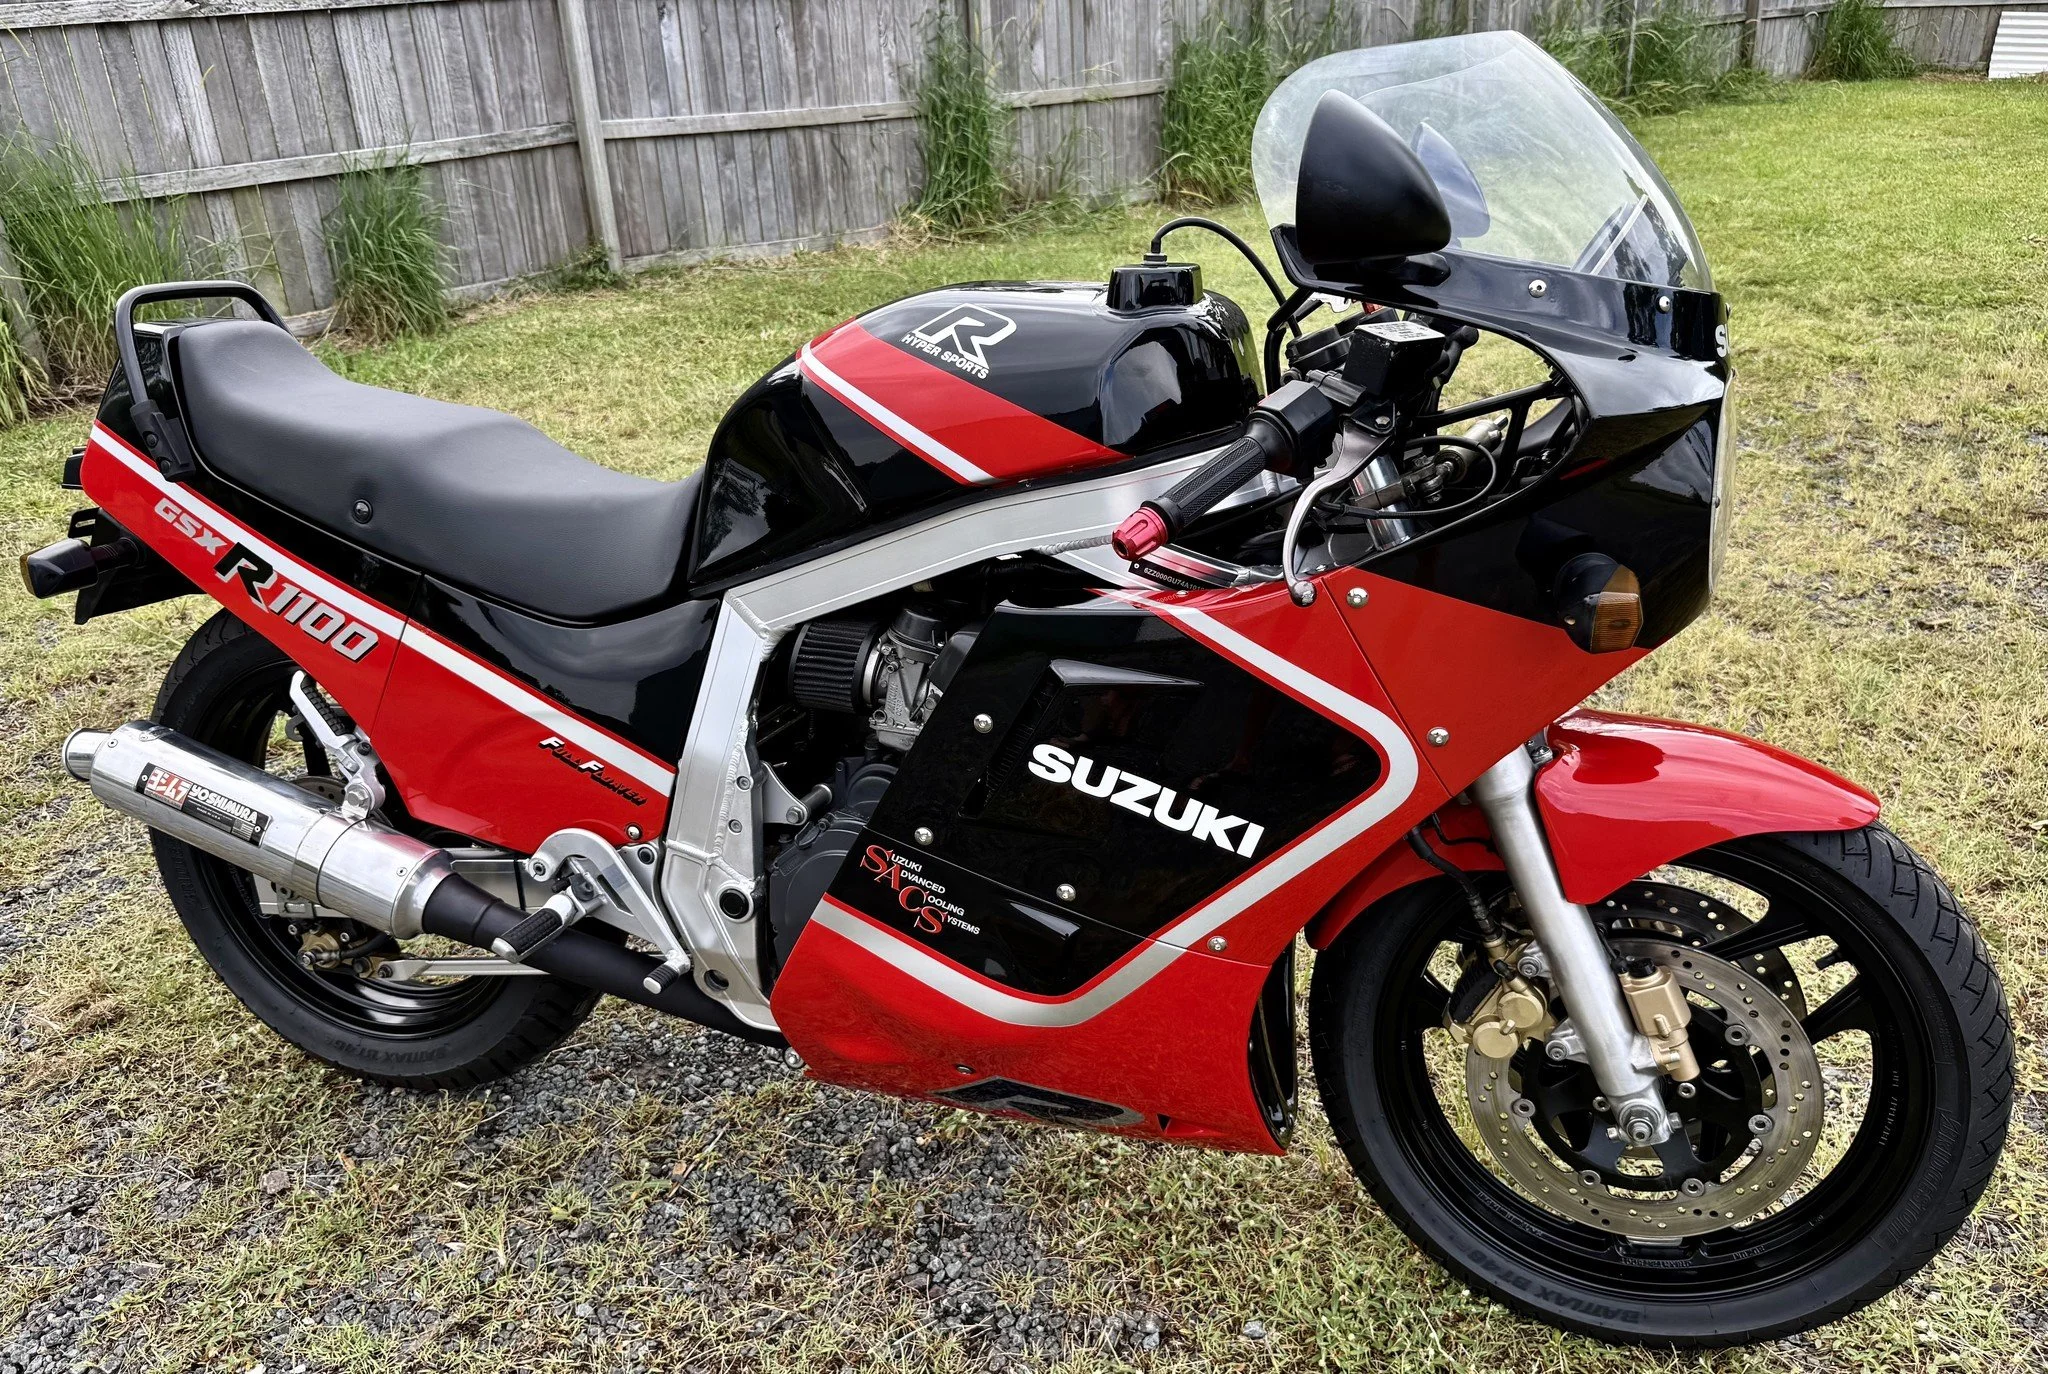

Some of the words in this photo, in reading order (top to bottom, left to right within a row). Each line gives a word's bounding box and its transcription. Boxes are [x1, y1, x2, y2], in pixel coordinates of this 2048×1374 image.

[900, 333, 942, 357] HYPER
[940, 350, 990, 380] SPORTS
[911, 303, 1017, 370] R
[154, 497, 227, 556] GSX
[188, 783, 258, 824] YOSHIMURA
[1028, 743, 1265, 859] SUZUKI
[860, 844, 922, 872] SUZUKI
[873, 863, 945, 894] ADVANCED
[899, 885, 965, 916] COOLING
[914, 905, 980, 935] SYSTEMS
